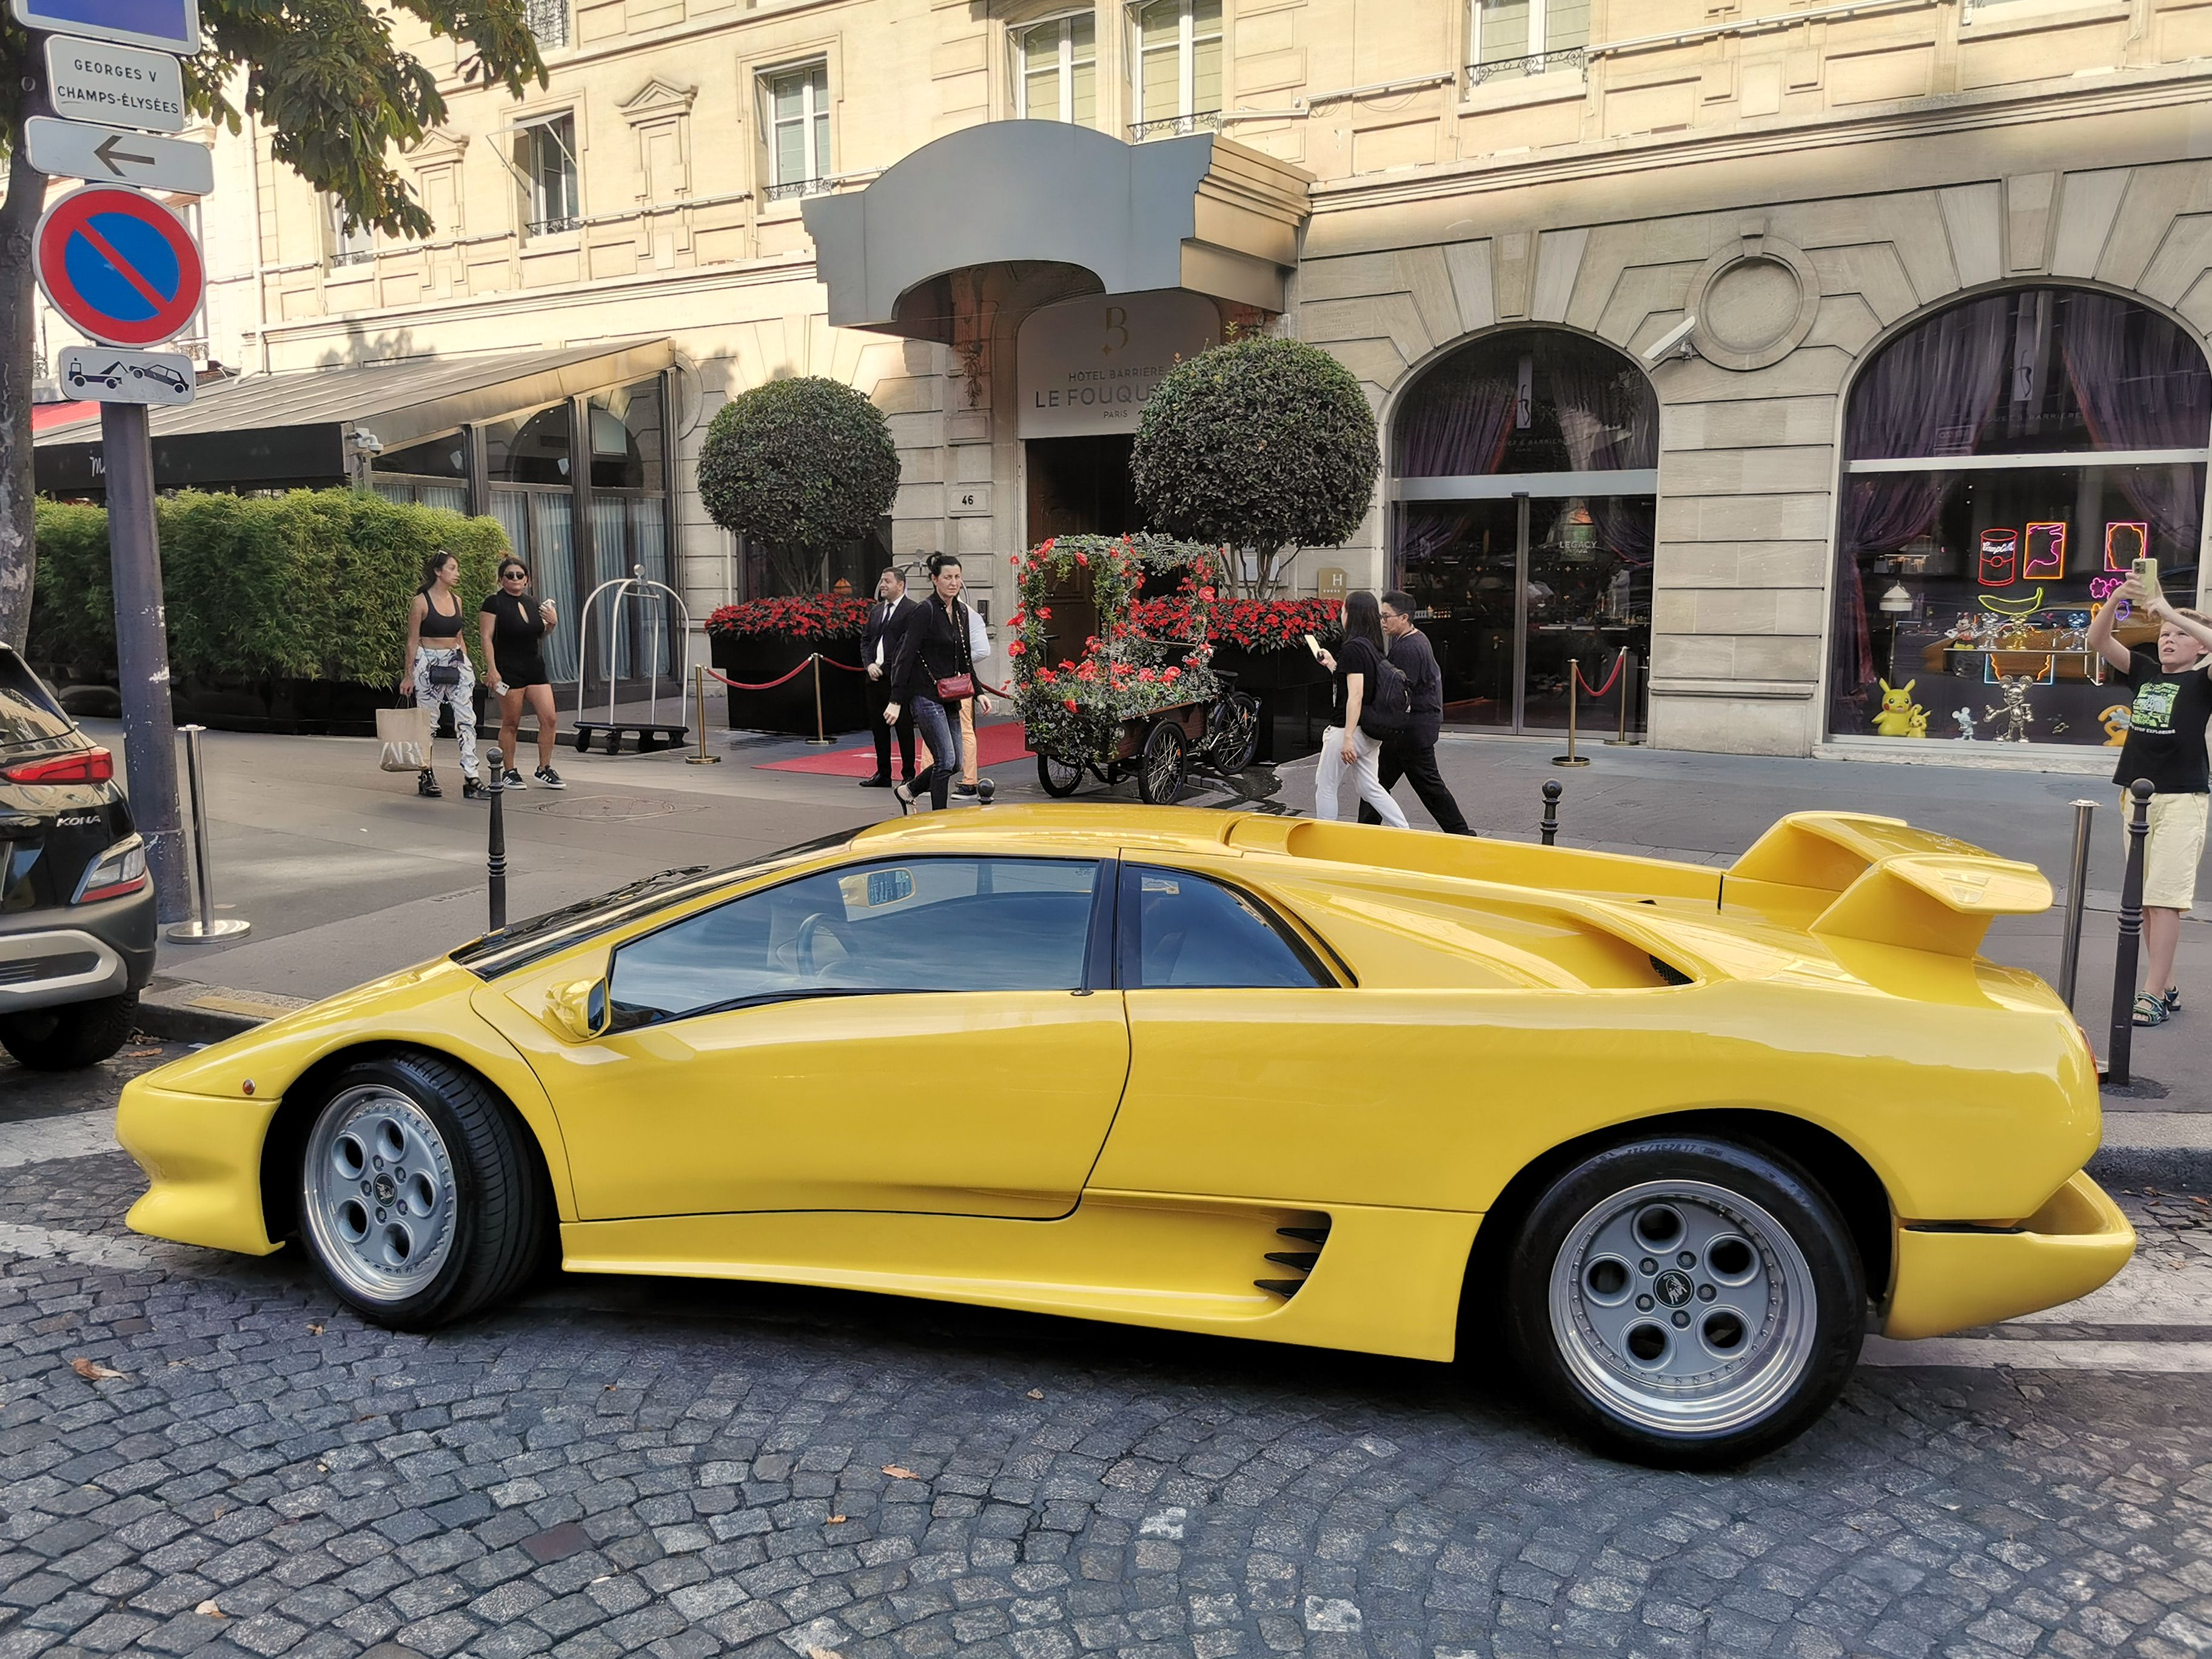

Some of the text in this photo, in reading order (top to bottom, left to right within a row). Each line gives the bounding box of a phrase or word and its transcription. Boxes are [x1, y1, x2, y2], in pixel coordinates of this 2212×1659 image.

[75, 59, 156, 82] GEORGES V
[58, 85, 179, 114] CHAMPS-ÉLYSÉES
[1068, 370, 1105, 382] HÔTEL
[1036, 383, 1150, 408] LE FOUQU
[1103, 410, 1128, 419] PARIS
[962, 495, 973, 505] 46
[1559, 540, 1597, 549] LEGACY
[1333, 574, 1342, 586] H
[56, 815, 101, 828] KONA
